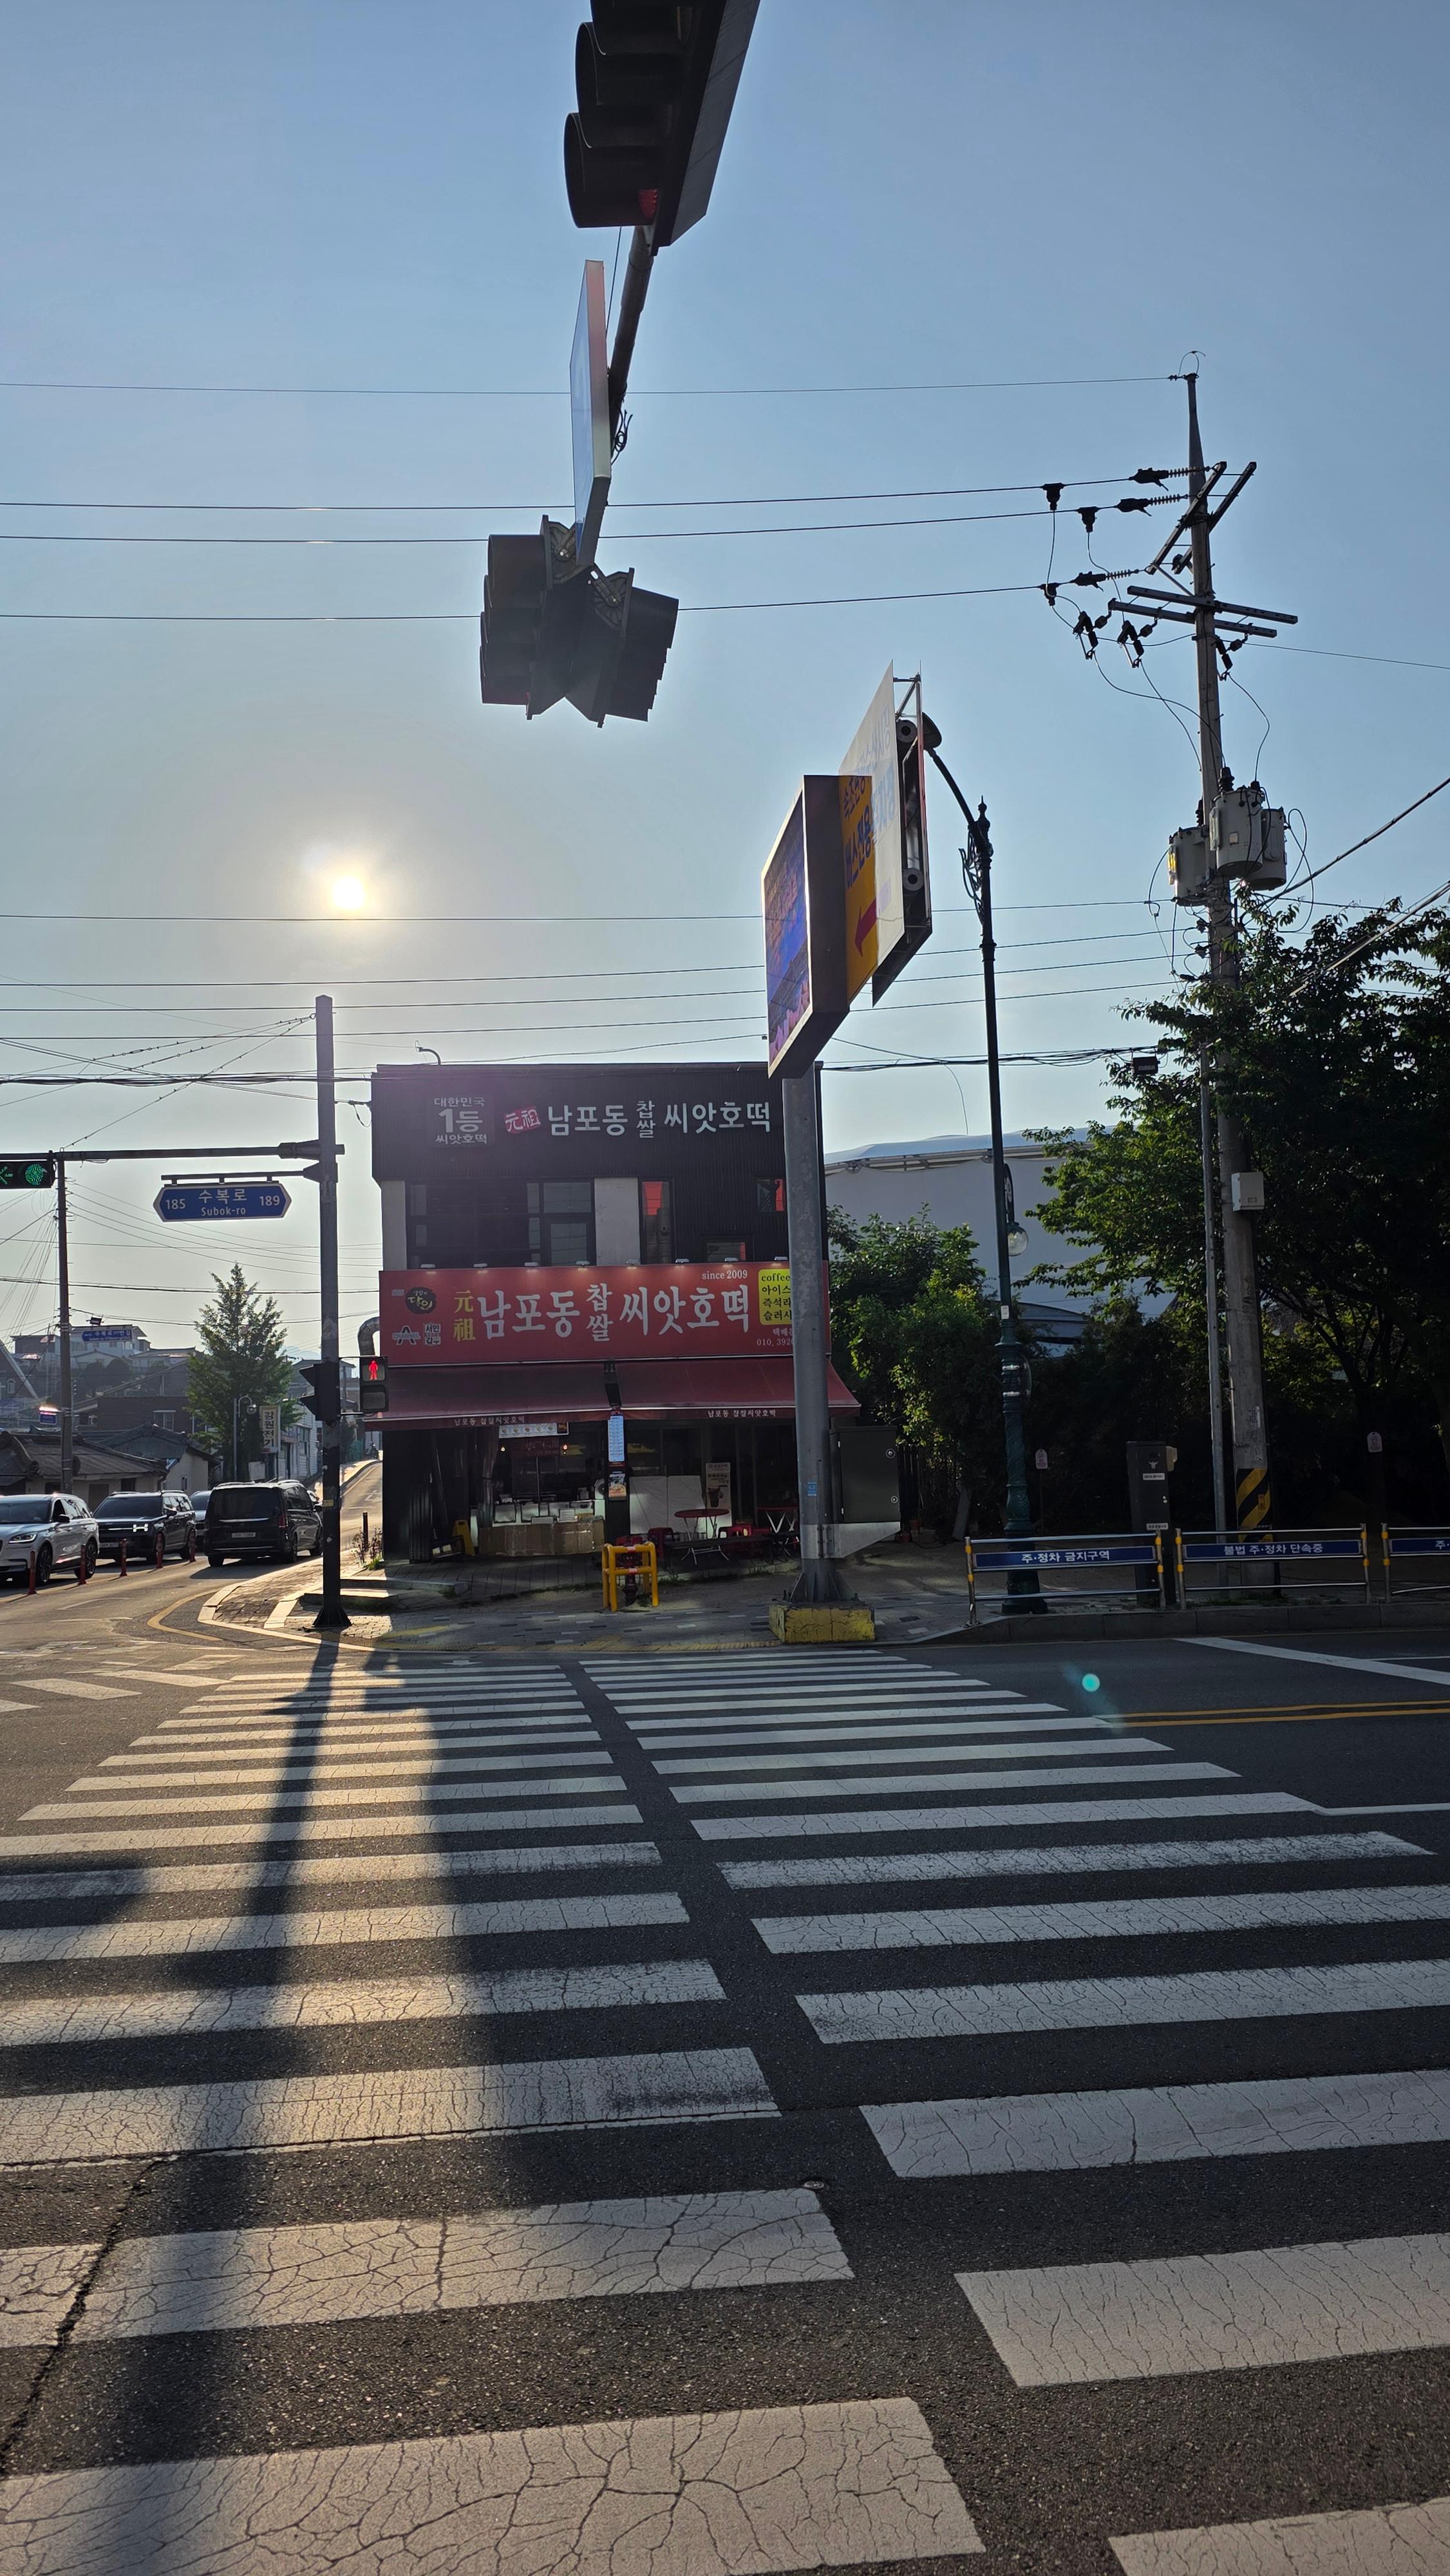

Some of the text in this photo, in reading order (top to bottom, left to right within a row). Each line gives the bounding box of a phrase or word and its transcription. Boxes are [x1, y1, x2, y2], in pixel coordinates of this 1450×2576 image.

[434, 1097, 485, 1107] 대한민국
[438, 1108, 483, 1133] 1등
[505, 1108, 541, 1133] 元祖
[548, 1100, 771, 1139] 남포동 찹쌀 씨앗호떡
[435, 1133, 487, 1144] 씨앗호떡
[198, 1188, 247, 1204] 수복로
[259, 1195, 281, 1206] 189
[165, 1198, 186, 1210] 185
[201, 1207, 246, 1217] Subok-ro
[702, 1269, 748, 1280] since 2009
[761, 1273, 791, 1282] coffee
[762, 1285, 791, 1295] 아이스
[453, 1289, 476, 1343] 元祖
[477, 1283, 749, 1342] 남포동 찹쌀 씨앗호떡
[454, 1417, 476, 1426] 남포동
[264, 1411, 274, 1447] 강원전기
[1224, 1545, 1246, 1555] 불법
[1290, 1543, 1323, 1554] 단속중
[1064, 1550, 1109, 1562] 금지구역
